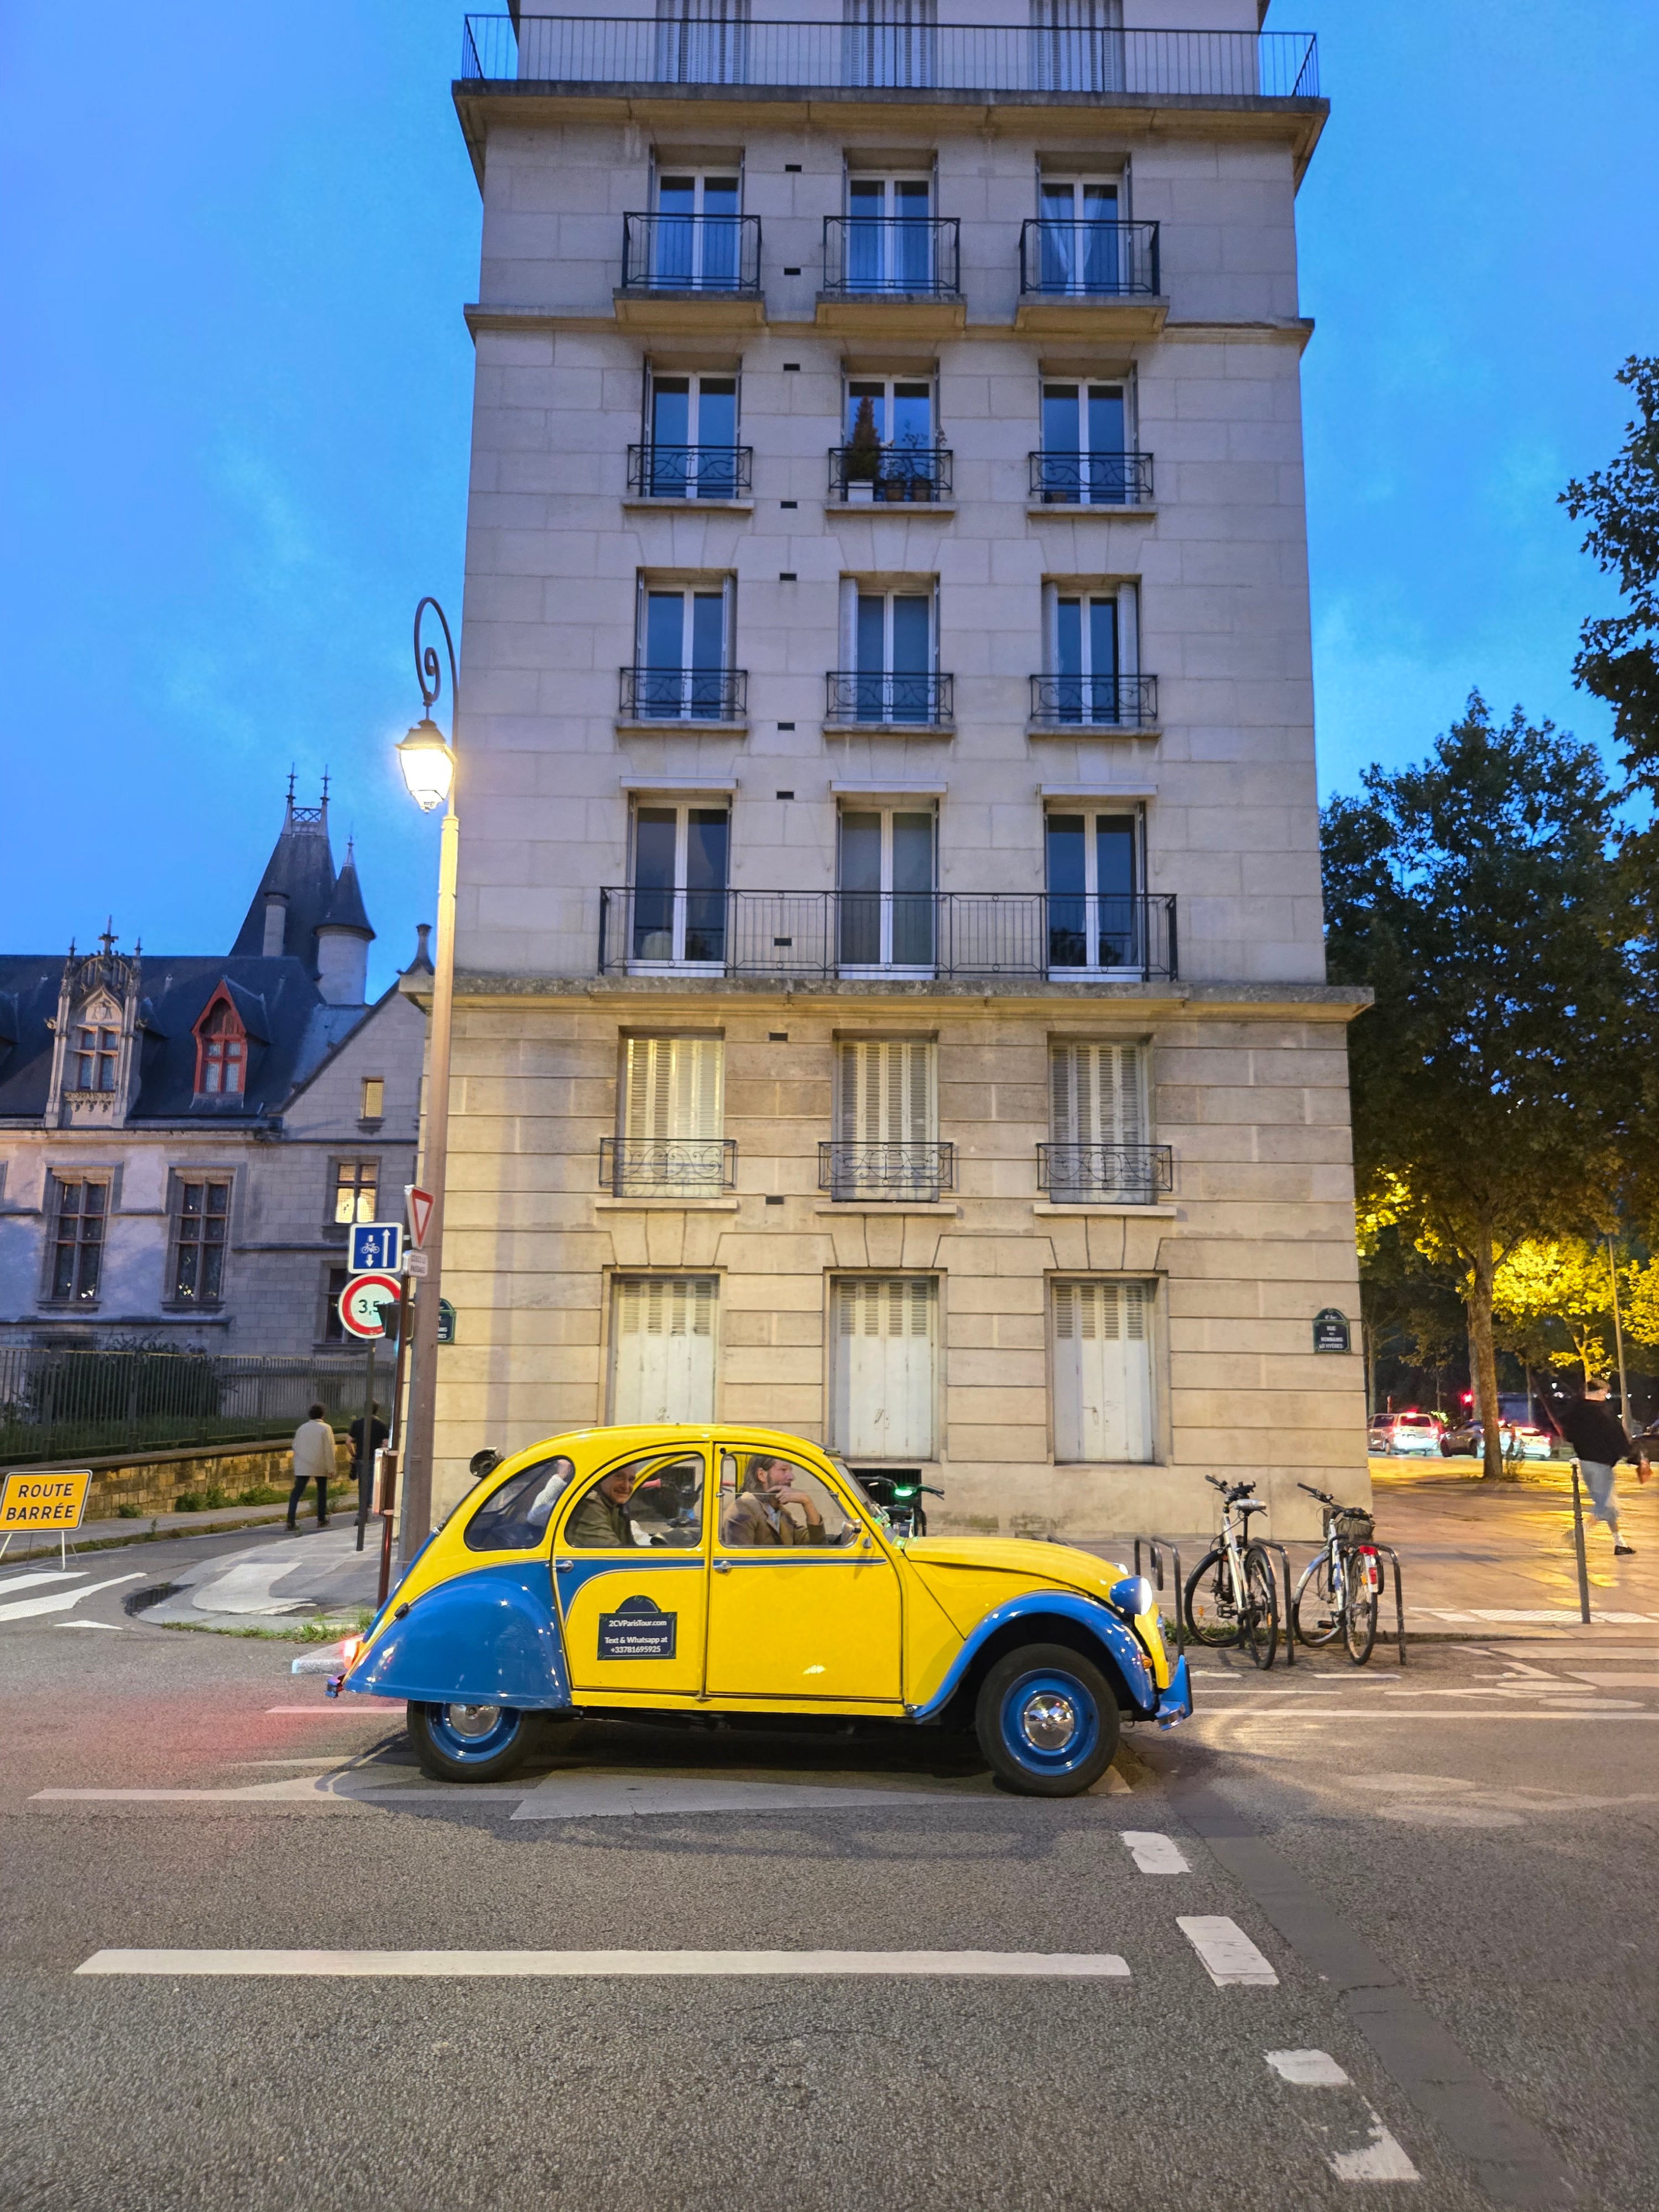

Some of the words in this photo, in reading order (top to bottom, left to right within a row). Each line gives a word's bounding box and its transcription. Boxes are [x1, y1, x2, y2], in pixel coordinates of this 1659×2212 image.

[358, 1299, 385, 1315] 3,5
[18, 1483, 74, 1498] ROUTE
[6, 1503, 75, 1520] BARRÉE
